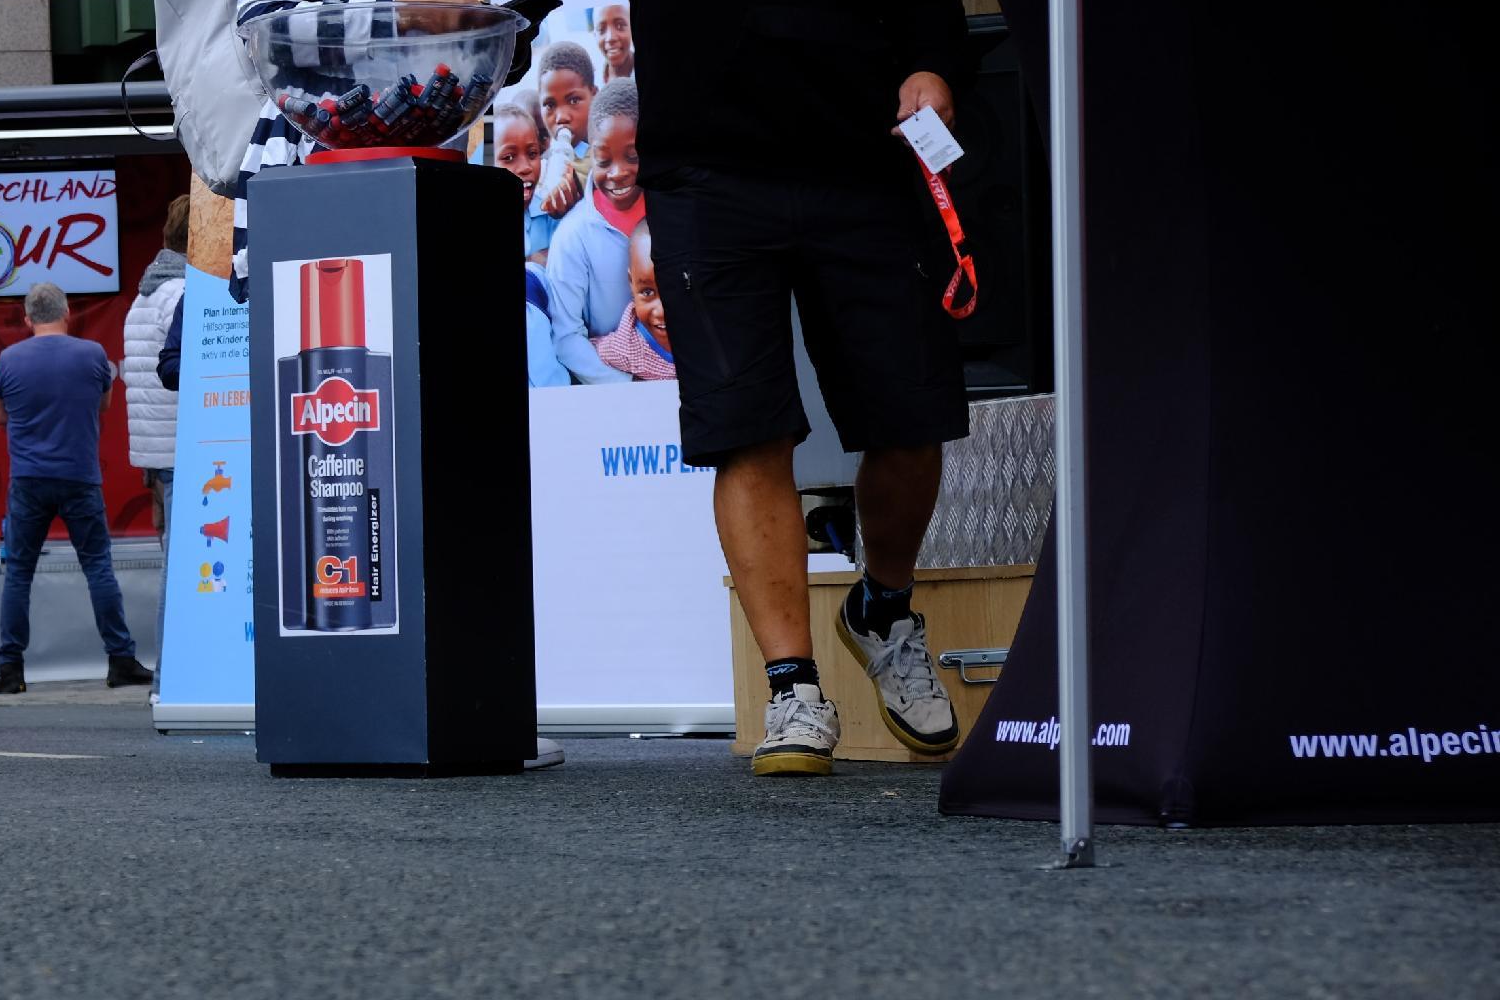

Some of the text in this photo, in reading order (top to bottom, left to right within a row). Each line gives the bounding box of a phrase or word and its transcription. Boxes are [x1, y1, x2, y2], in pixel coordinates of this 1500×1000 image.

[203, 308, 220, 318] Plan
[201, 337, 215, 346] der
[217, 335, 243, 345] Kinder
[203, 392, 219, 408] EIN
[300, 395, 371, 432] Alpecin
[308, 454, 364, 477] Caffeine
[310, 479, 364, 500] Shampoo
[370, 494, 379, 596] Hair Energizer
[316, 555, 358, 585] C1
